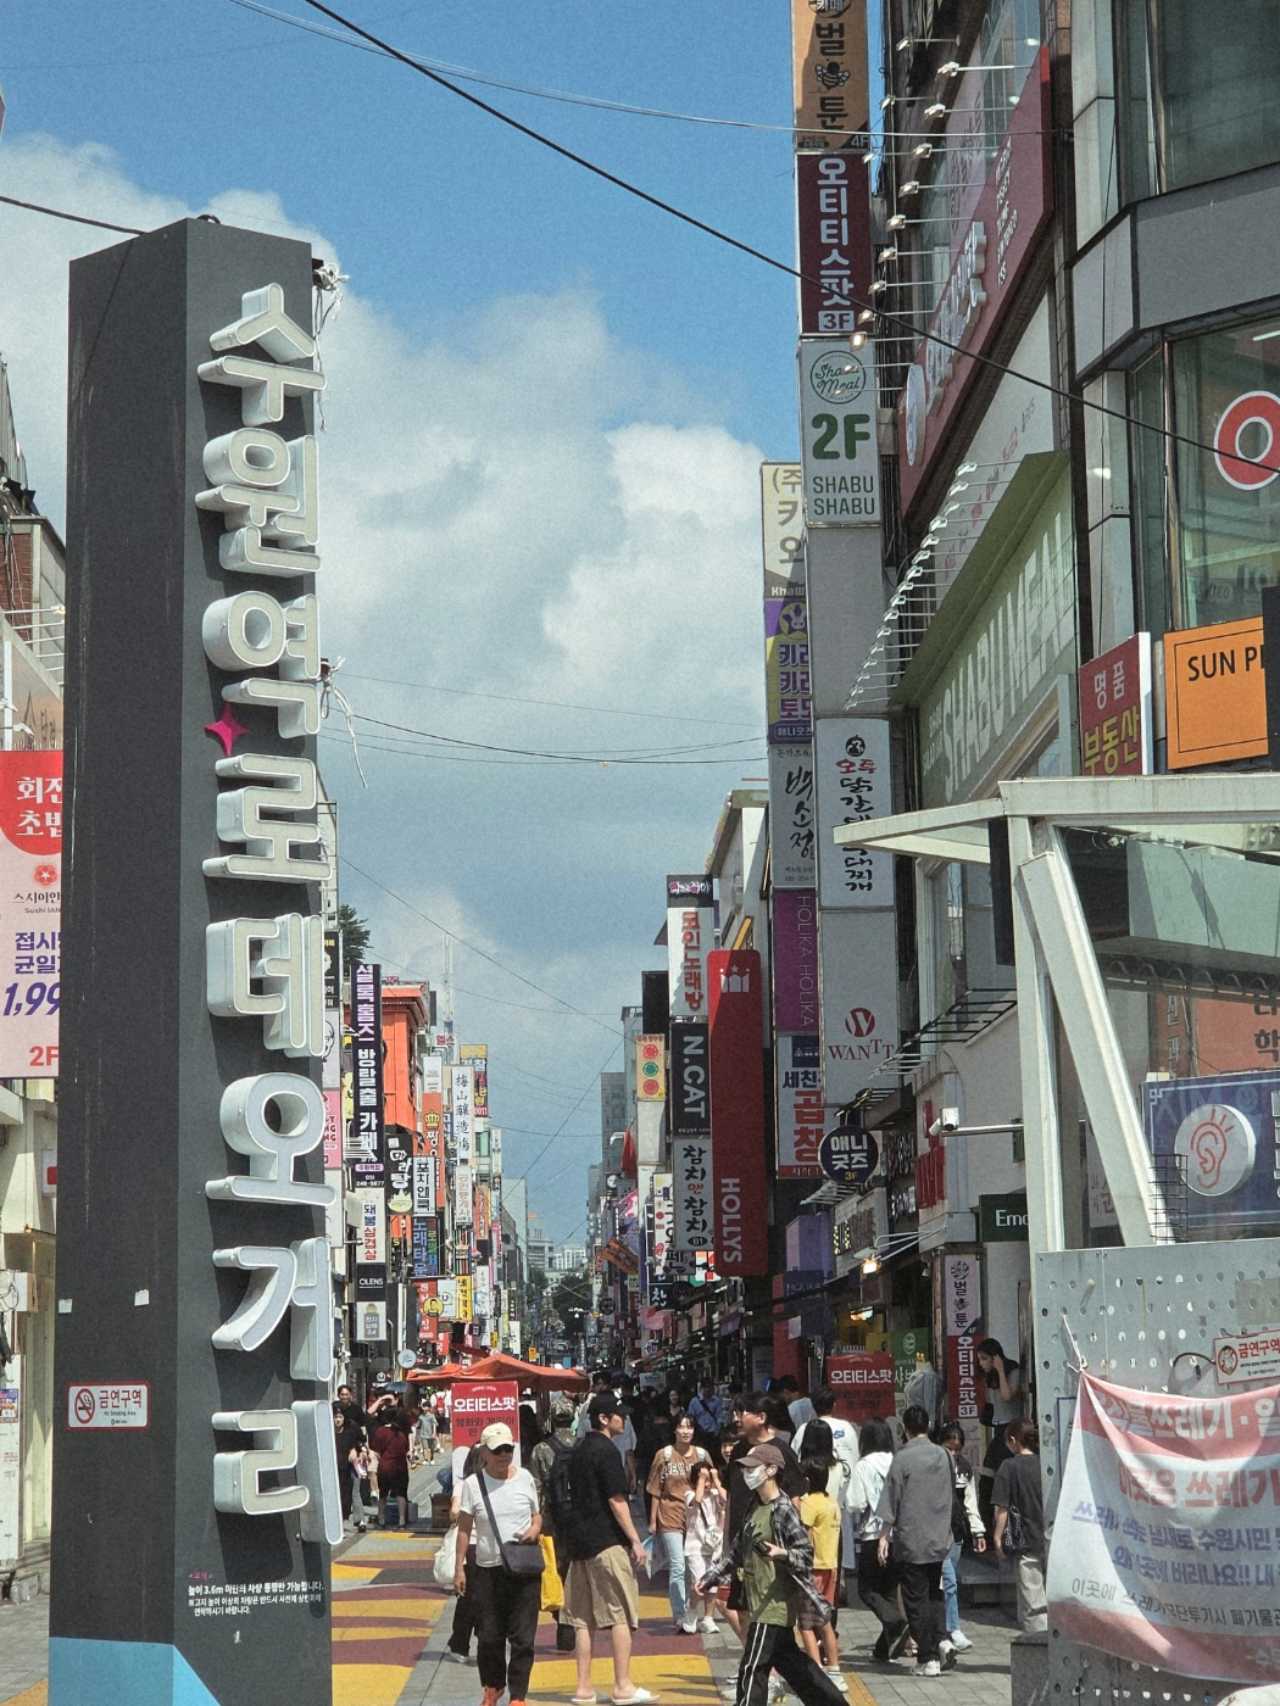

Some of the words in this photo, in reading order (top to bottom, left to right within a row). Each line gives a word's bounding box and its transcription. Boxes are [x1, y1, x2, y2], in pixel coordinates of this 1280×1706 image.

[823, 312, 851, 331] 3F
[812, 413, 871, 460] 2F
[812, 475, 874, 494] SHABU
[814, 497, 875, 515] SHABU
[1188, 649, 1236, 682] SUN
[1094, 660, 1125, 710] 명품
[1084, 704, 1141, 776] 부동산
[797, 895, 812, 957] HOLIKA
[16, 931, 63, 951] 접시
[16, 955, 62, 975] 균일
[800, 964, 815, 1027] HOLIKA
[30, 1046, 60, 1067] 2F
[358, 1049, 376, 1107] 방탈출
[683, 1036, 706, 1118] N.CAT
[783, 1070, 821, 1089] 세친
[360, 1112, 378, 1150] 카페
[831, 1134, 869, 1152] 애니
[832, 1152, 869, 1170] 굿즈
[721, 1178, 742, 1264] HOLLYS
[99, 1389, 142, 1409] 금연구역
[453, 1397, 516, 1412] 오티티스팟
[961, 1405, 976, 1416] 3F
[1198, 1527, 1271, 1551] 수원시민
[204, 1585, 224, 1595] 3.6m
